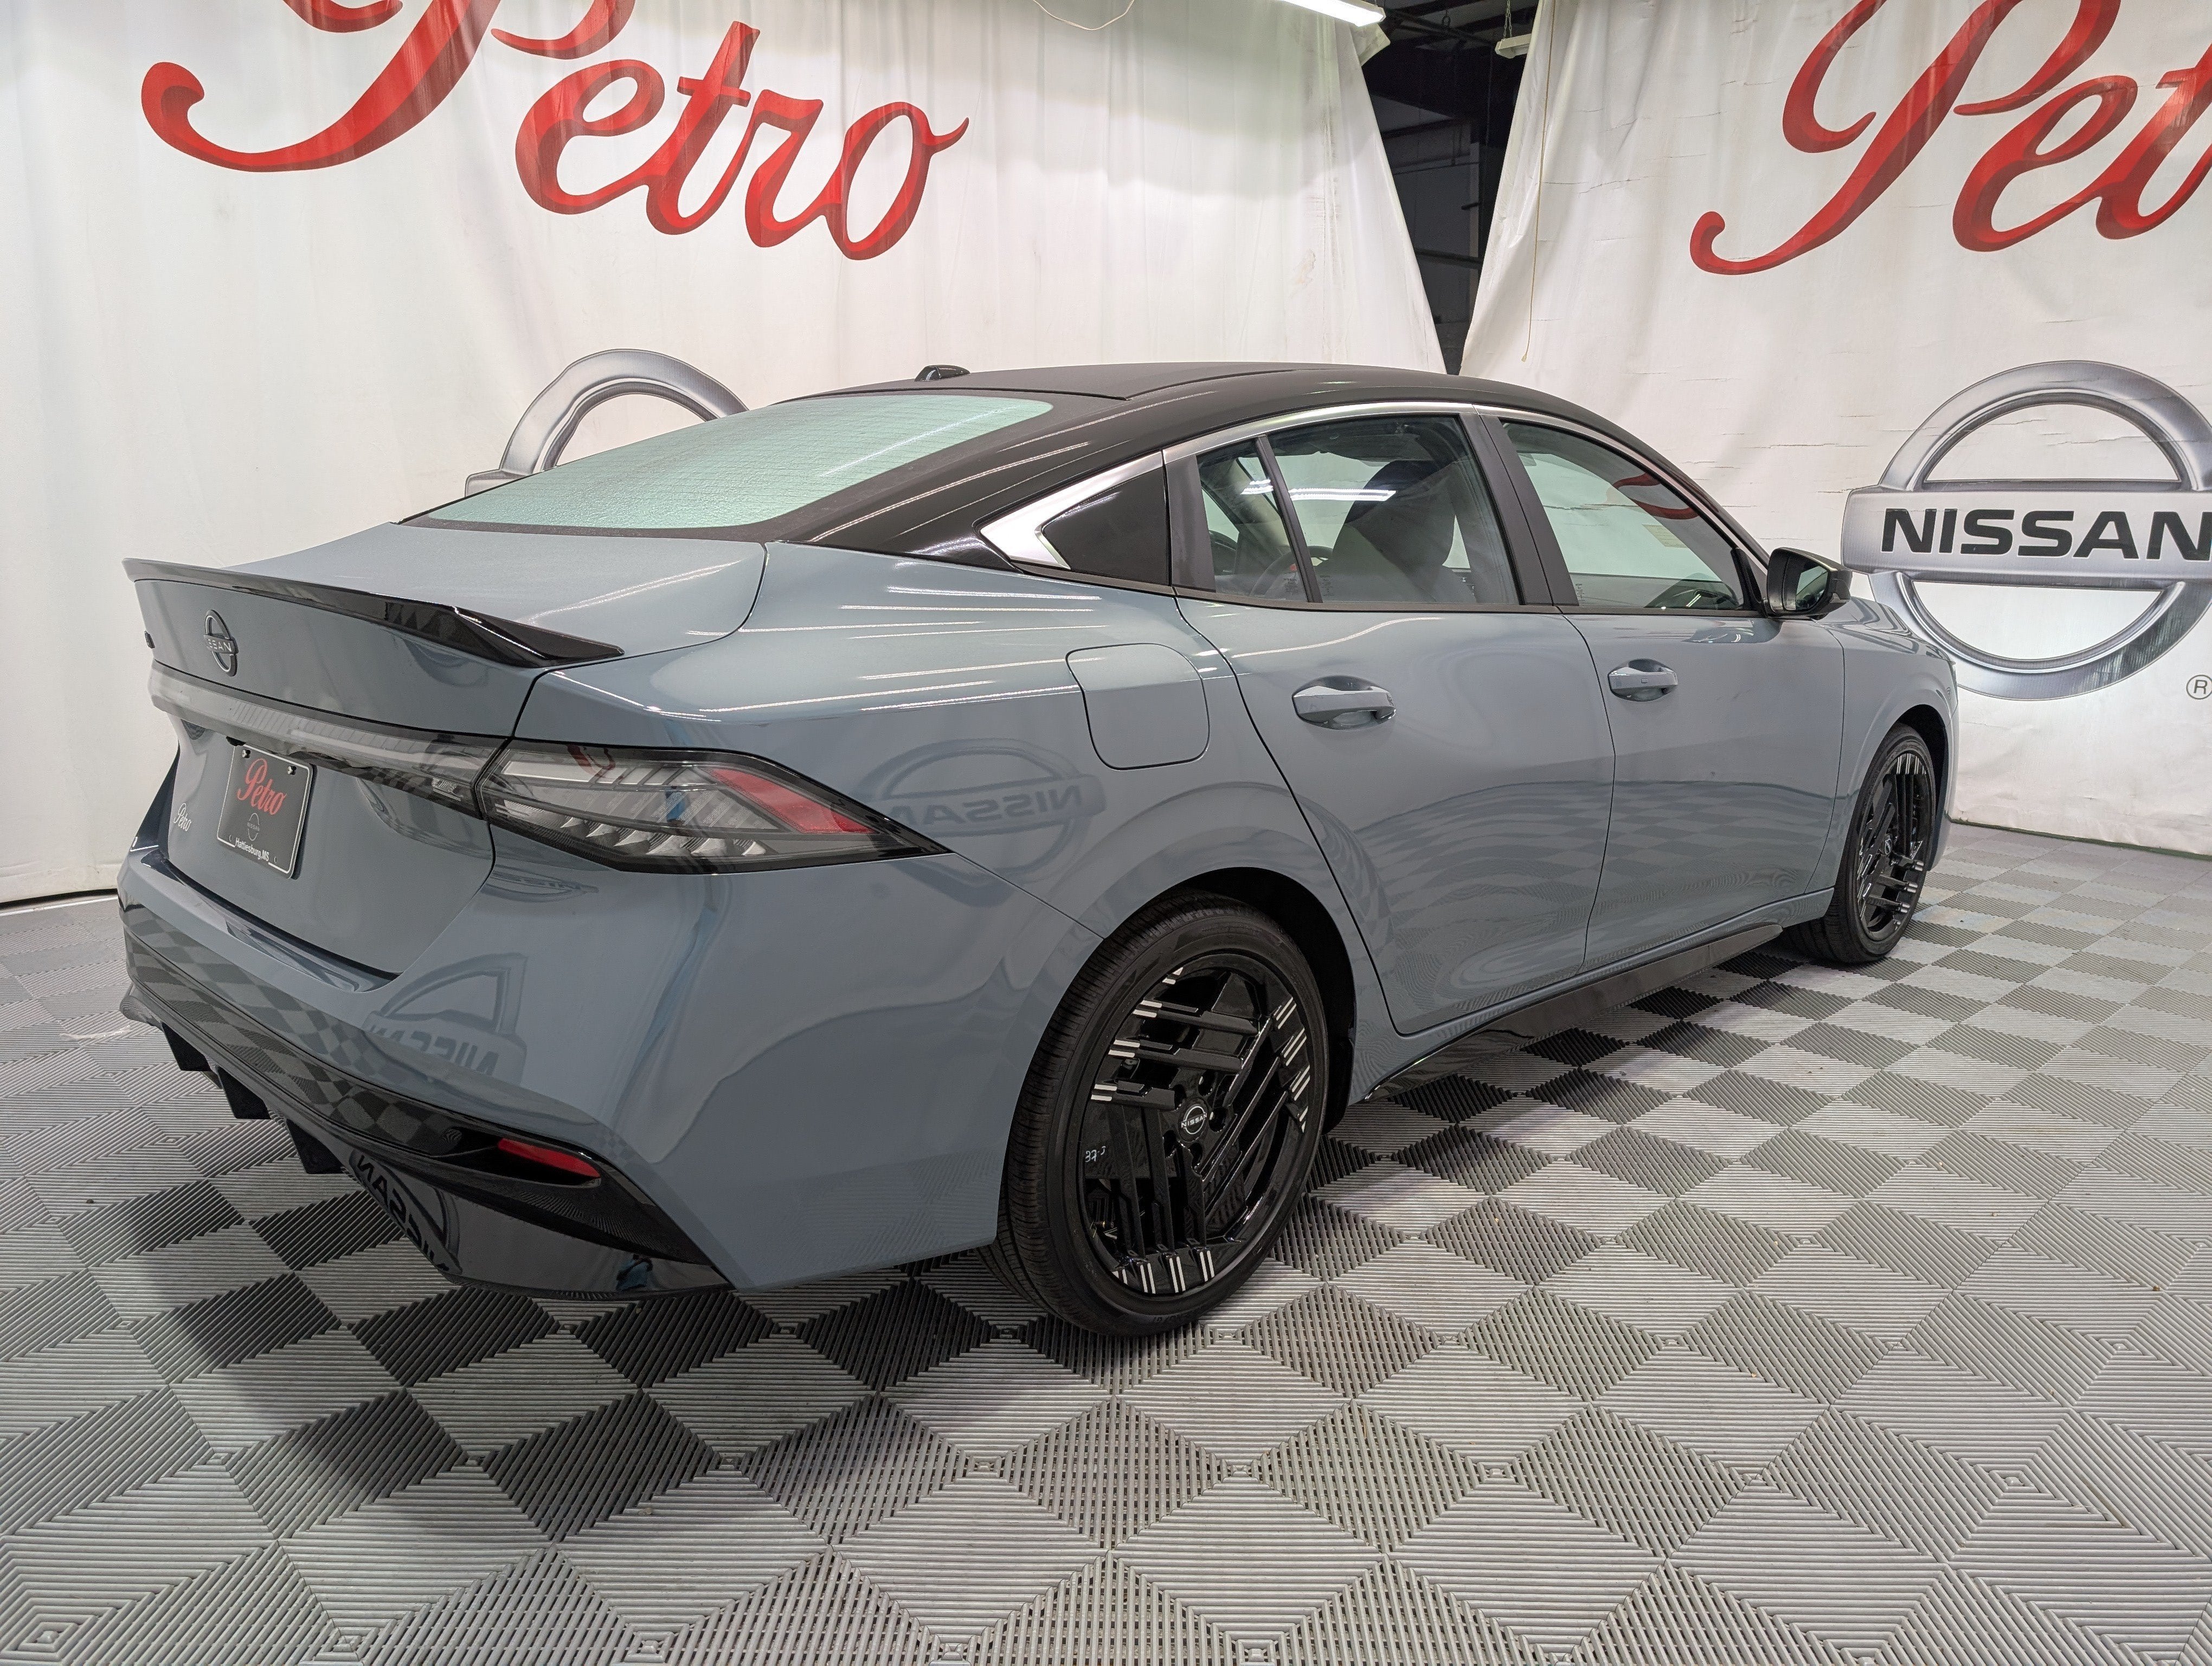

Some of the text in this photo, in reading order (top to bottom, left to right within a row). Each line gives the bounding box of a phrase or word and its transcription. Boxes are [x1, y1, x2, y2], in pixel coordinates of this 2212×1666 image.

[1881, 508, 2212, 561] NISSAN
[237, 758, 287, 815] Petro
[173, 803, 192, 832] Petro
[1181, 1112, 1207, 1128] NISSAN
